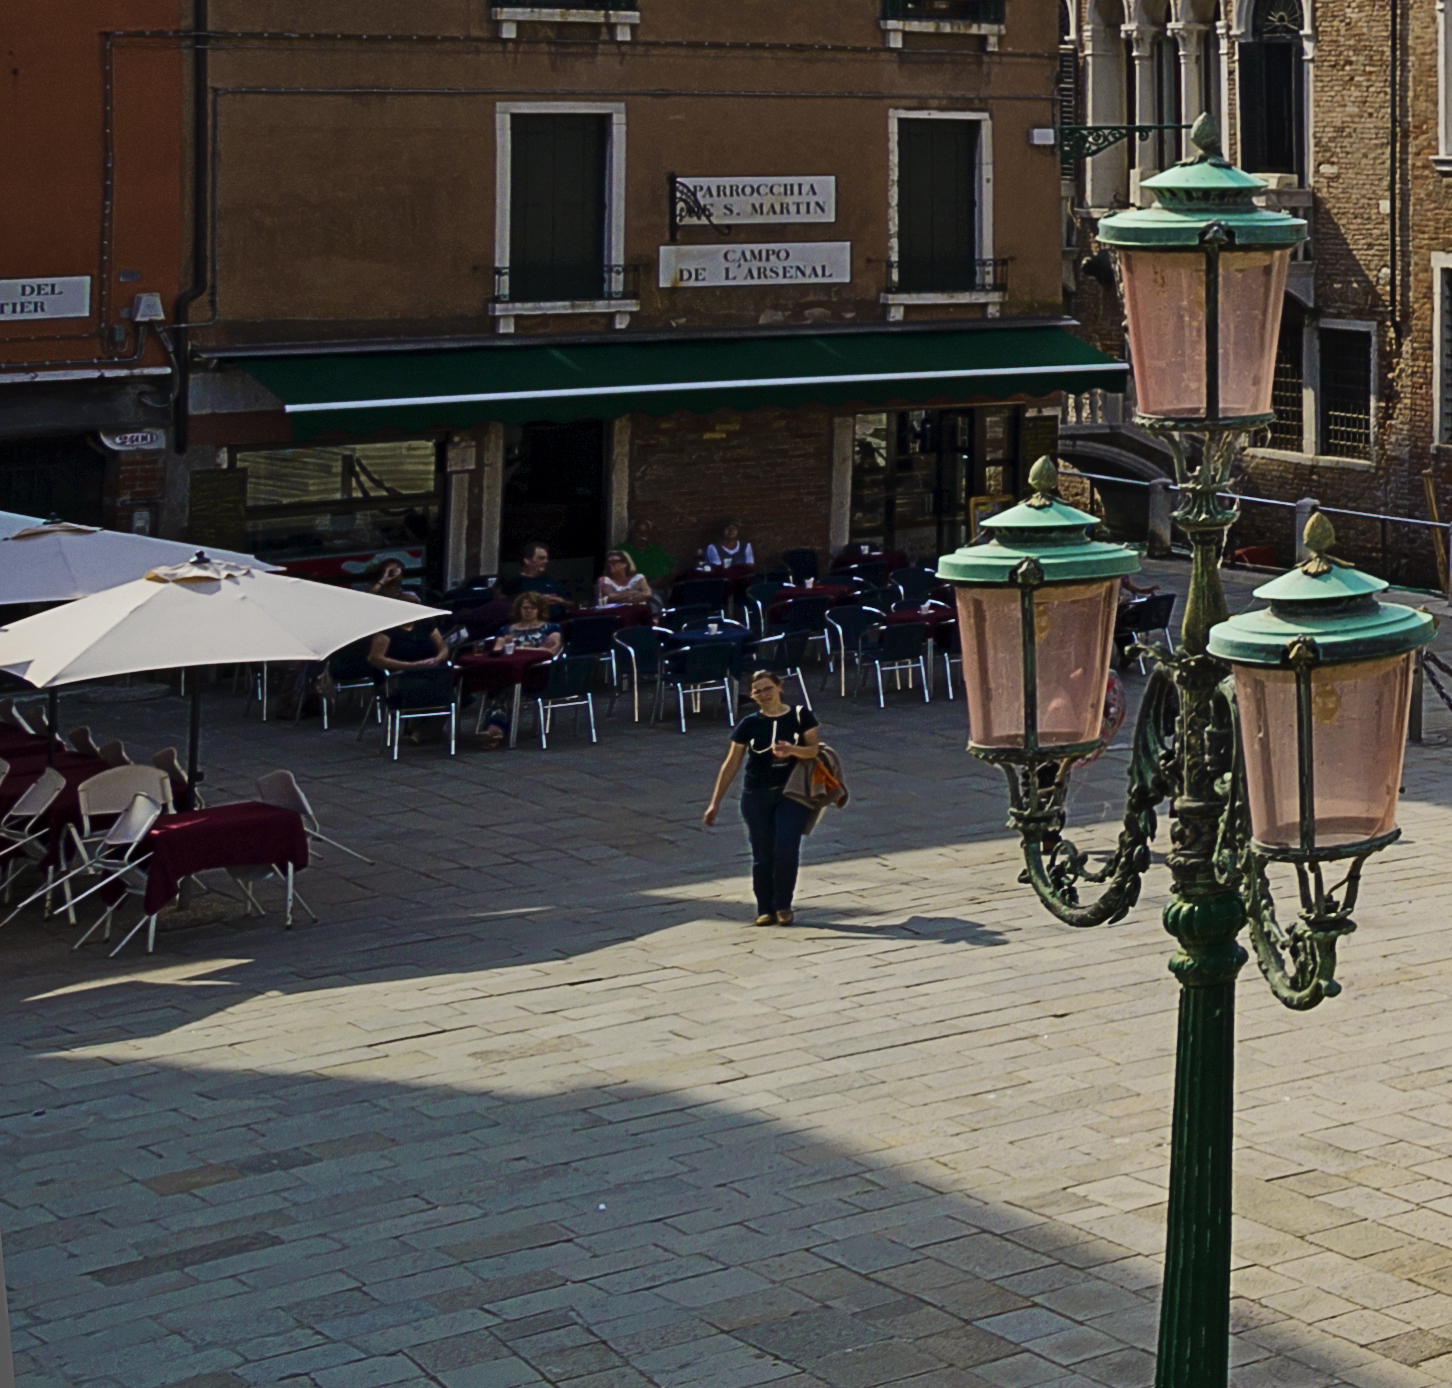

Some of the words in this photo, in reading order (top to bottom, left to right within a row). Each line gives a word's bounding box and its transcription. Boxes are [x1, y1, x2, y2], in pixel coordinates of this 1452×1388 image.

[693, 182, 818, 199] PARROCCHIA
[723, 203, 741, 217] S.
[750, 201, 826, 216] MARTIN
[723, 249, 790, 263] CAMPO
[679, 267, 706, 282] DE
[724, 262, 833, 281] L'ARSENAL
[20, 283, 63, 297] DEL
